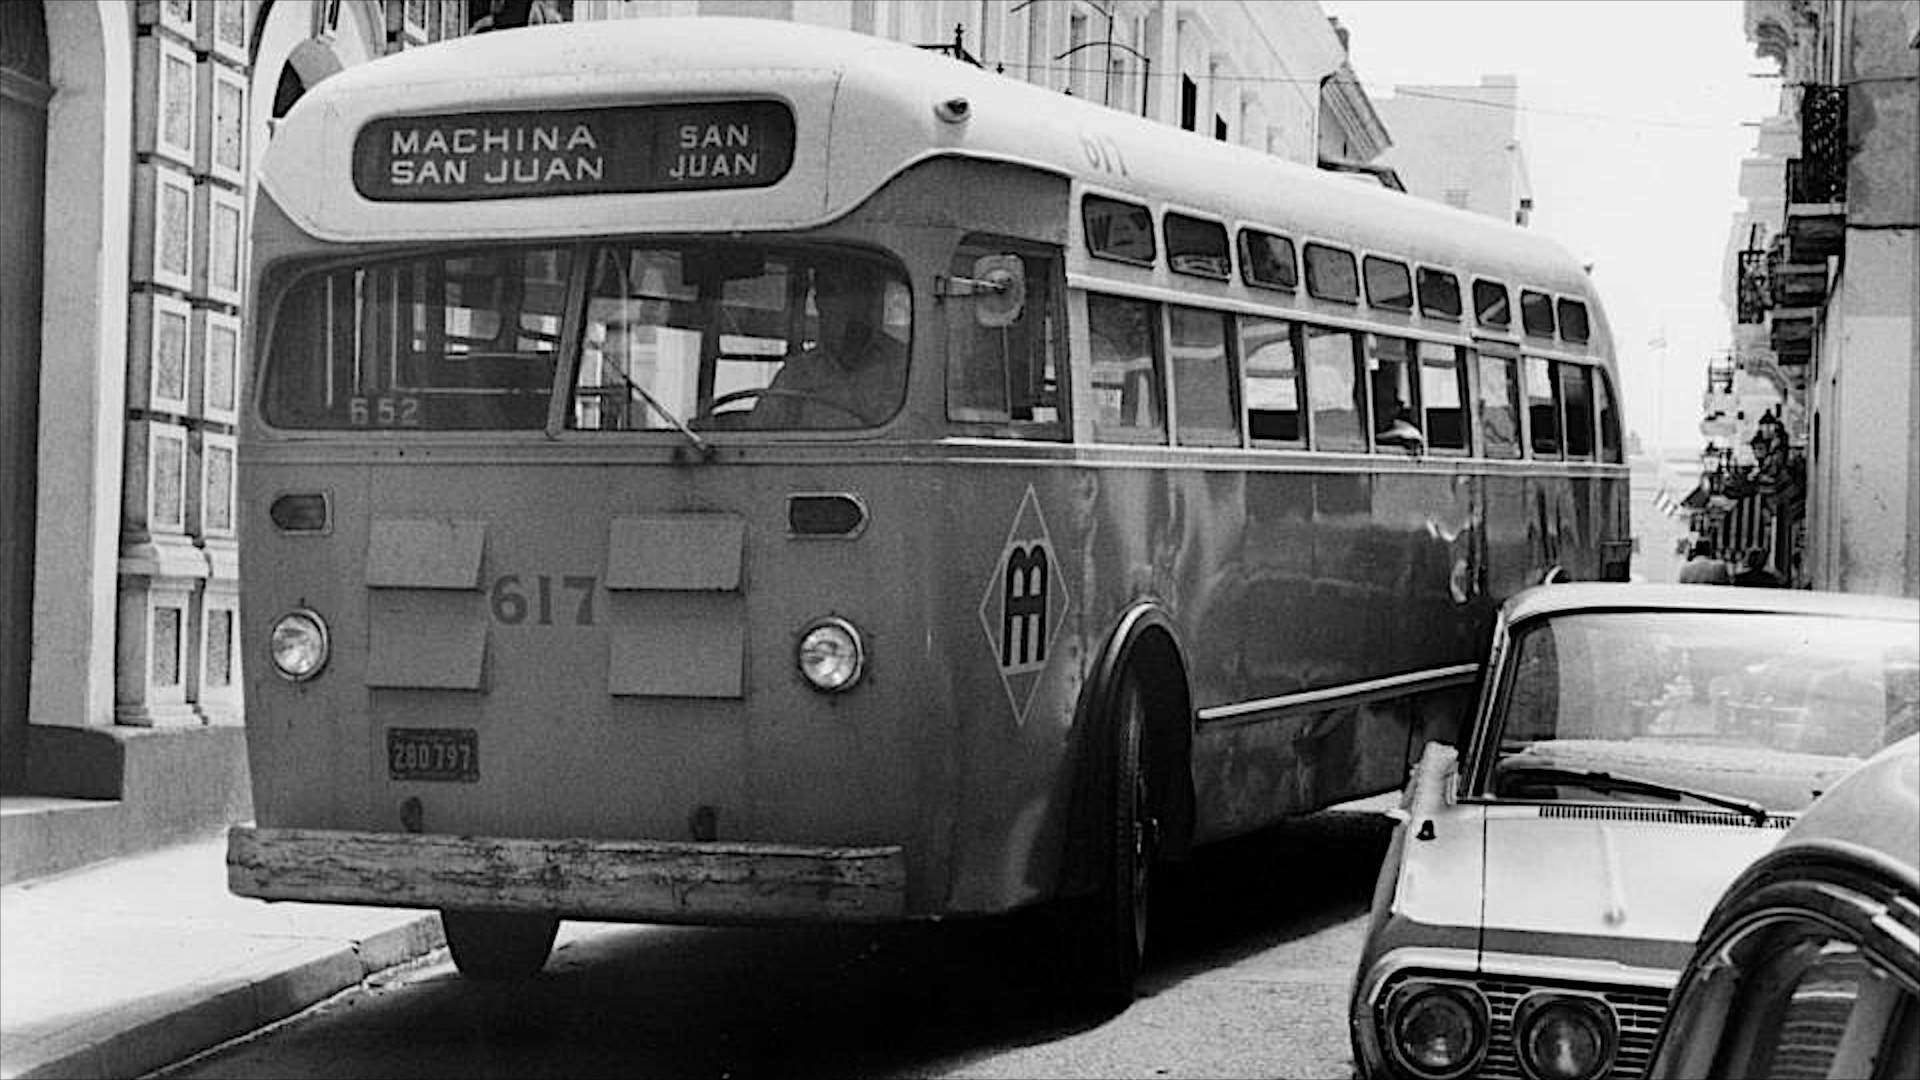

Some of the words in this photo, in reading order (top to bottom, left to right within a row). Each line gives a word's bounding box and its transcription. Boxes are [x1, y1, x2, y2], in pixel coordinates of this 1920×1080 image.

[391, 125, 597, 154] MACHINA
[679, 124, 750, 148] SAN
[389, 160, 467, 184] SAN
[484, 157, 604, 183] JUAN
[669, 152, 758, 178] JUAN
[351, 397, 419, 426] 652
[490, 574, 597, 626] 617
